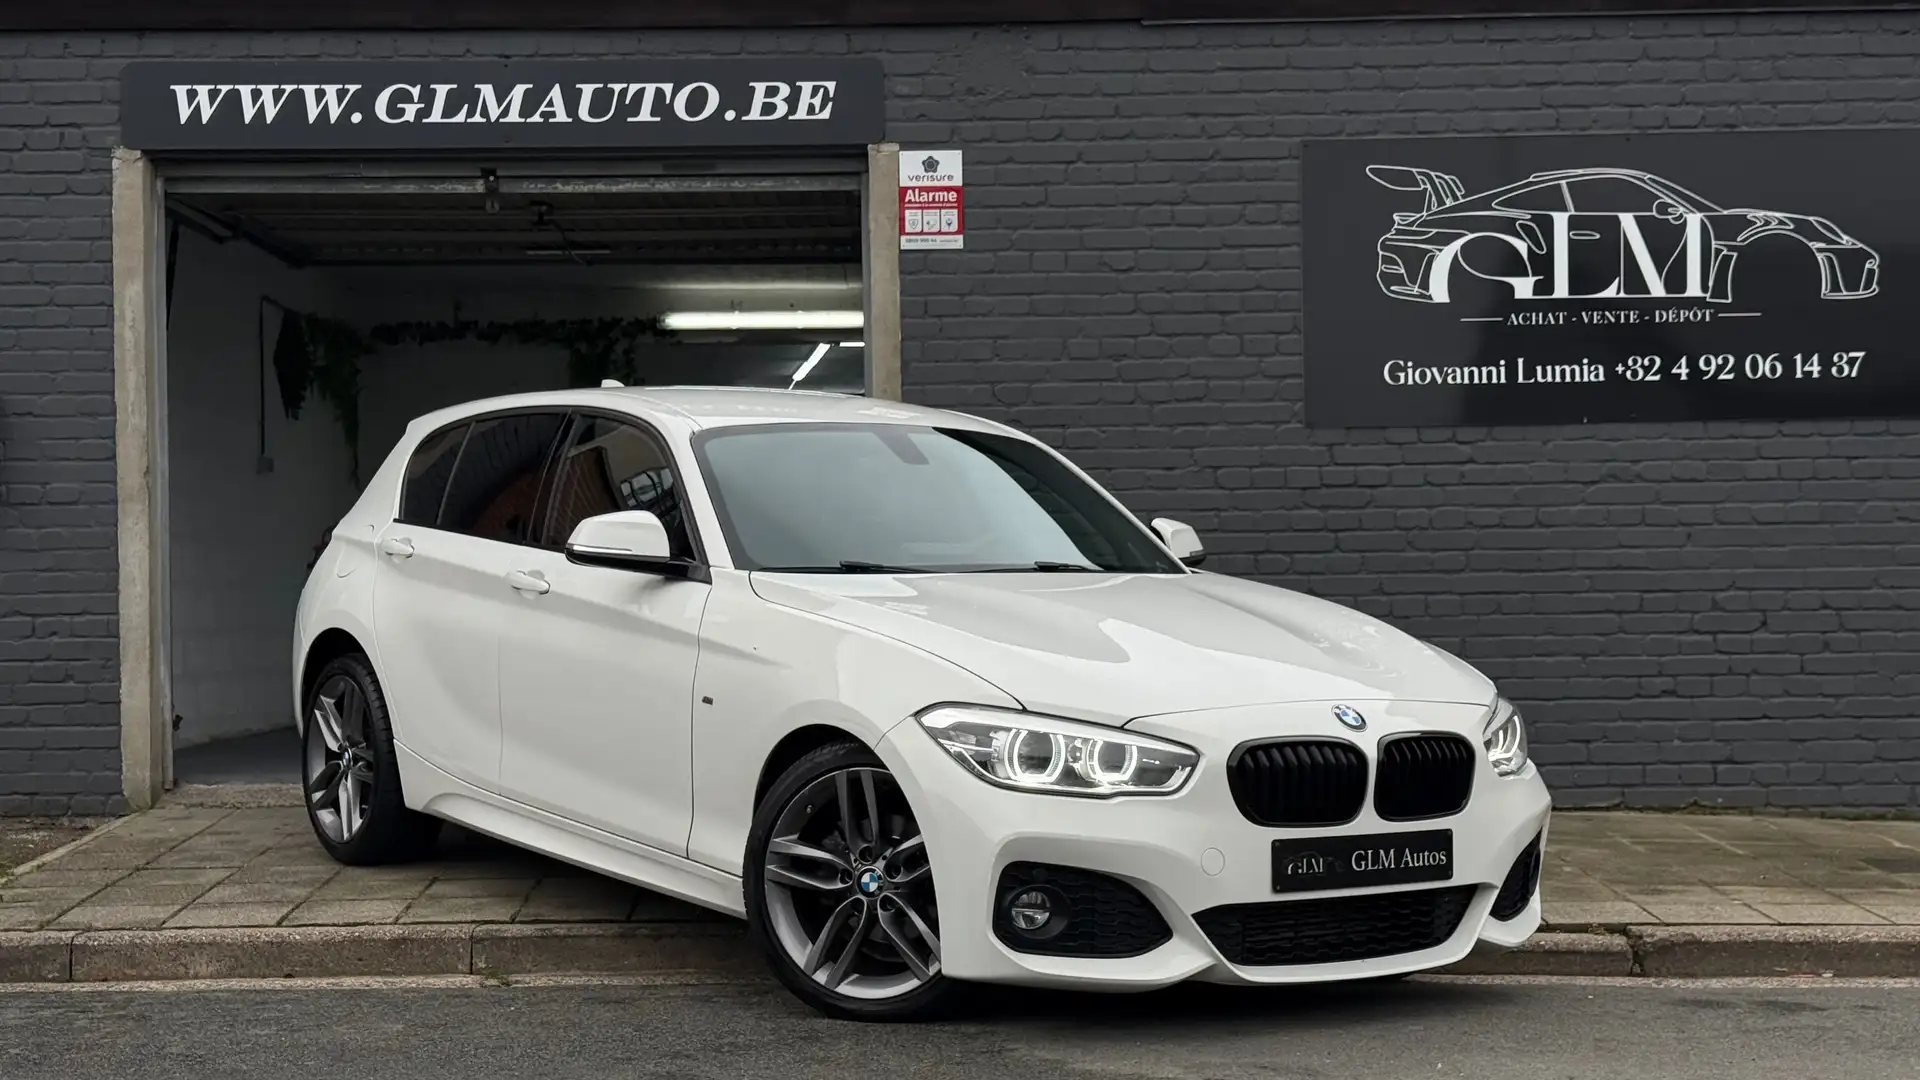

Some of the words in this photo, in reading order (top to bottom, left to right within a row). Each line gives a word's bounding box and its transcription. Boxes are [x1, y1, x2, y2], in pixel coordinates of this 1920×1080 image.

[170, 80, 836, 125] WWW.GLMAUTO.BE
[907, 174, 955, 182] verisure
[904, 188, 958, 202] Alarme
[1507, 311, 1568, 326] ACHAT
[1581, 310, 1640, 324] VENTE
[1655, 306, 1714, 323] DÉPÔT
[1383, 359, 1507, 386] Giovanni
[1517, 357, 1606, 384] Lumia
[1614, 355, 1662, 382] +32
[1671, 355, 1690, 381] 4
[1698, 353, 1735, 380] 92
[1744, 352, 1783, 379] 06
[1793, 352, 1822, 379] 14
[1831, 351, 1866, 378] 37
[1351, 848, 1396, 871] GLM
[1399, 847, 1447, 868] Autos
